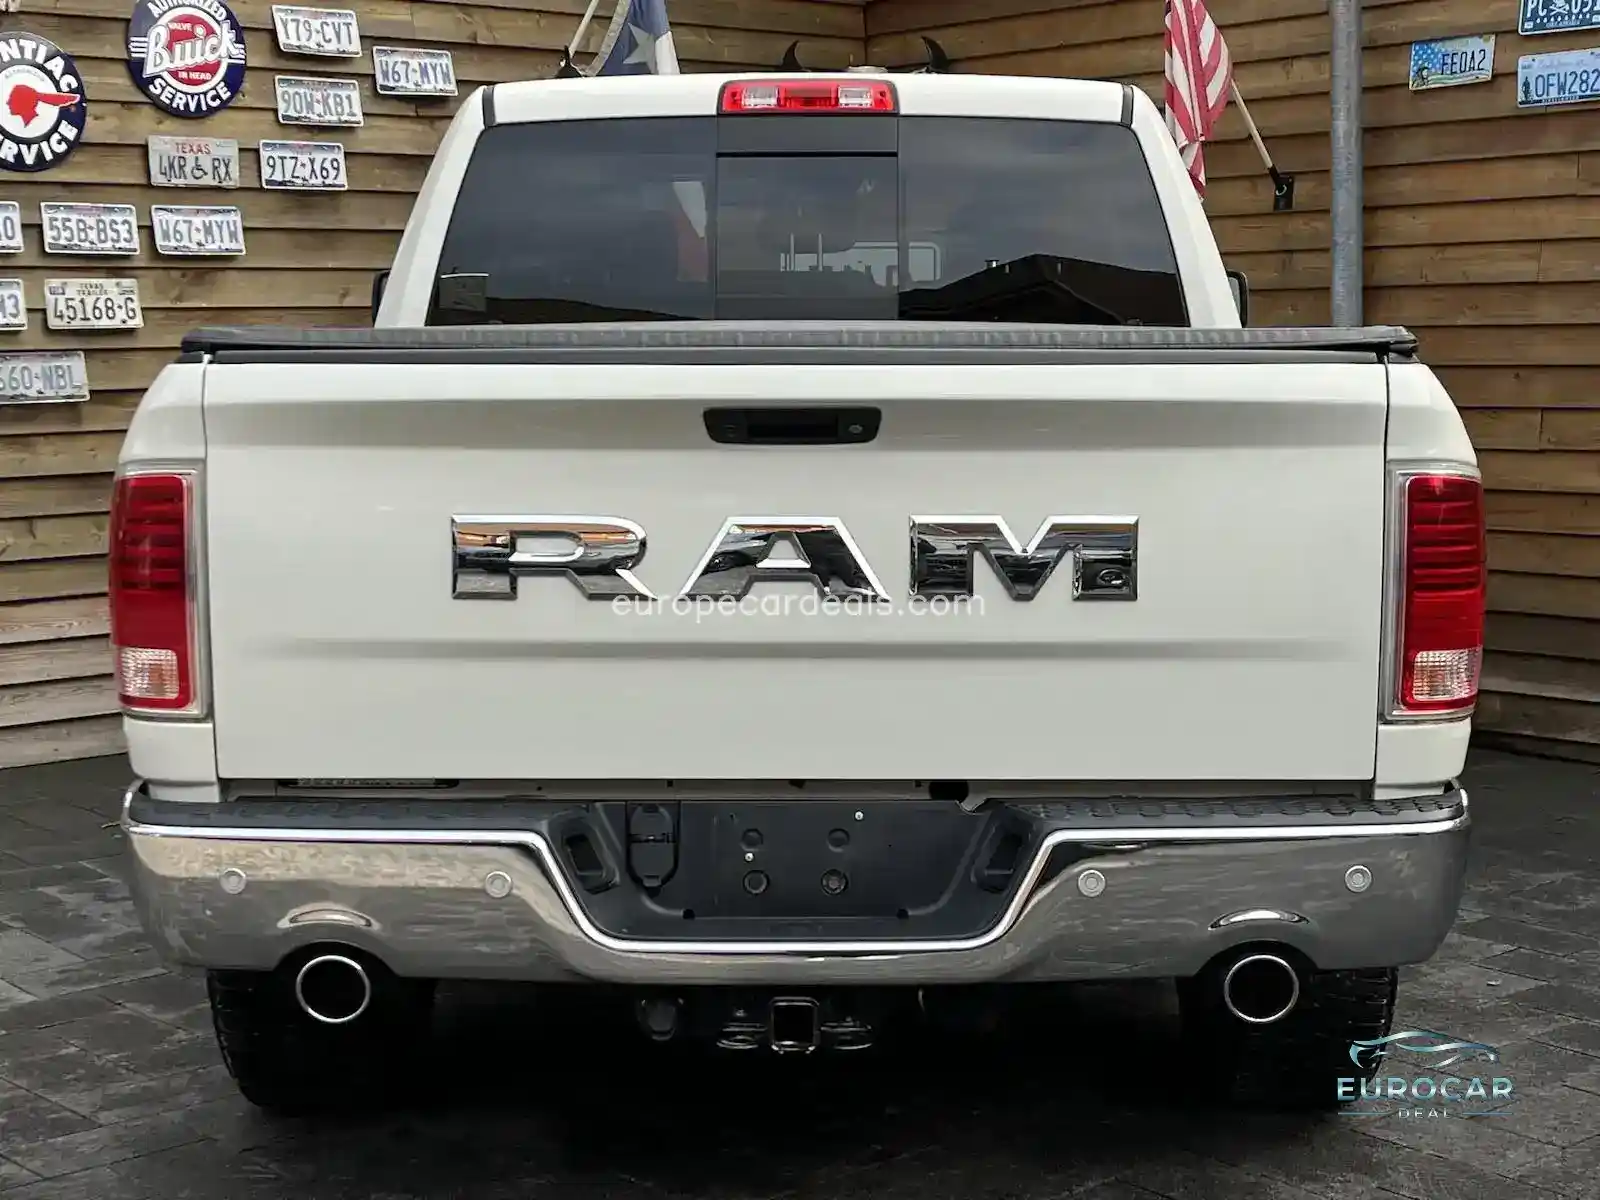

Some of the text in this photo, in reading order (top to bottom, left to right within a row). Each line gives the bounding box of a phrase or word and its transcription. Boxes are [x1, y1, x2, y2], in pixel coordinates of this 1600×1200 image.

[168, 22, 192, 31] VALVE
[143, 20, 242, 77] Buick
[0, 38, 78, 92] NTIAC
[177, 71, 212, 80] IN HEAD
[148, 77, 232, 113] SERVICE
[175, 142, 211, 154] TEXAS
[159, 155, 232, 182] 4KR RX
[451, 514, 1139, 600] RAM
